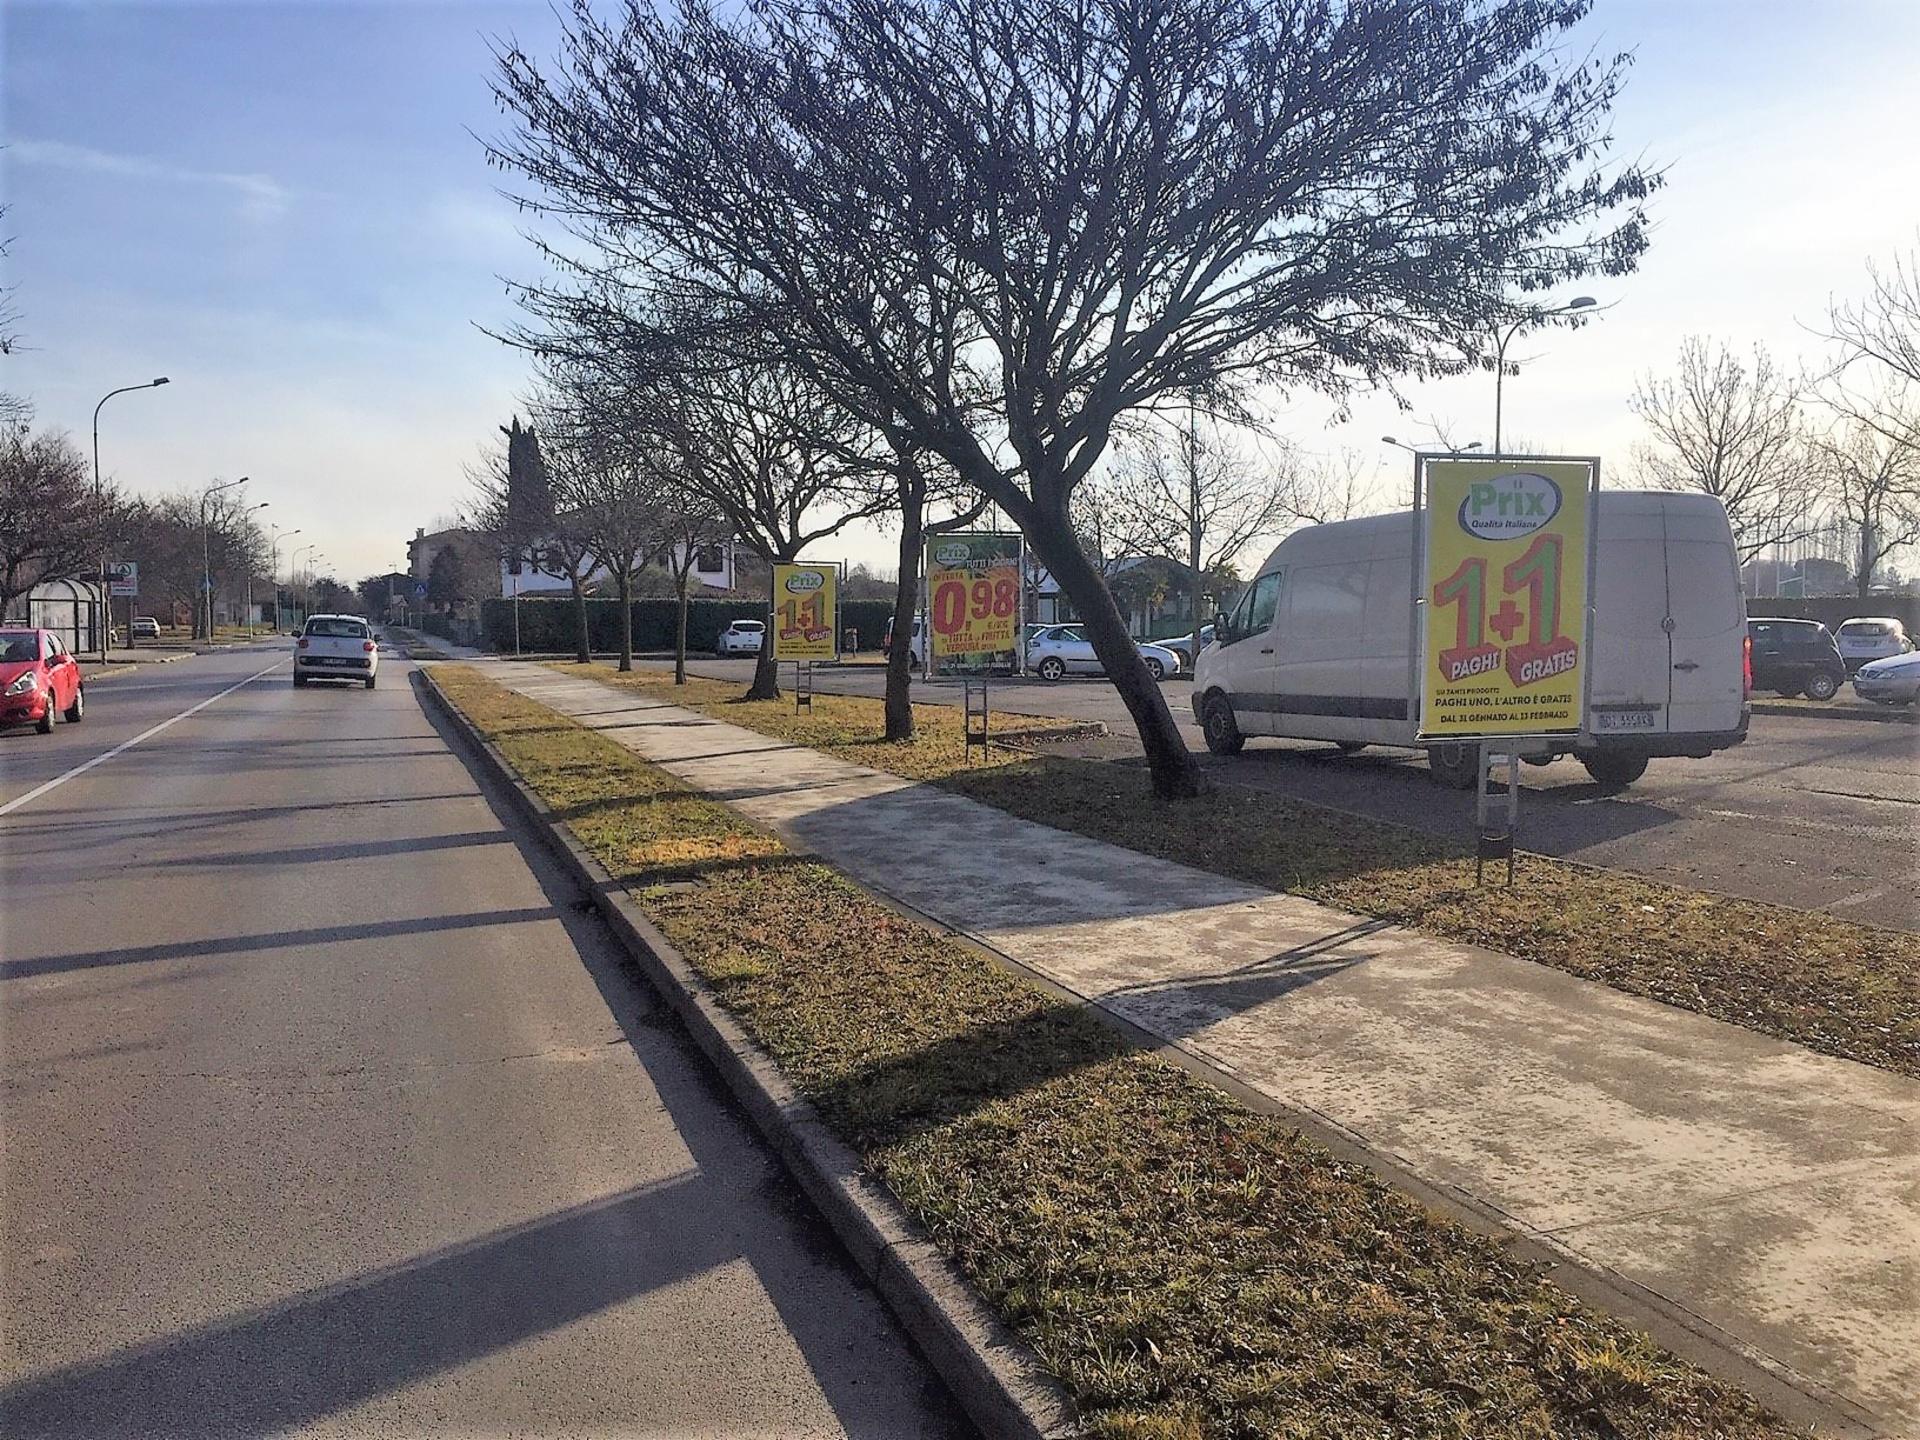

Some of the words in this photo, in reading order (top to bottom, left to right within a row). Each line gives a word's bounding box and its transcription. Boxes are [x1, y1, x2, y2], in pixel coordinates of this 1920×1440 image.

[1471, 481, 1546, 516] Prix
[790, 574, 820, 586] Prix
[1451, 653, 1499, 680] PAGHI
[1520, 650, 1576, 682] GRATIS
[1435, 698, 1467, 707] PAGHI
[1495, 695, 1531, 705] L'ALTRO
[1540, 694, 1572, 704] GRATIS
[1440, 715, 1457, 723] DAL
[1468, 713, 1508, 722] GENNAIO
[1530, 710, 1569, 719] FEBBRAIO
